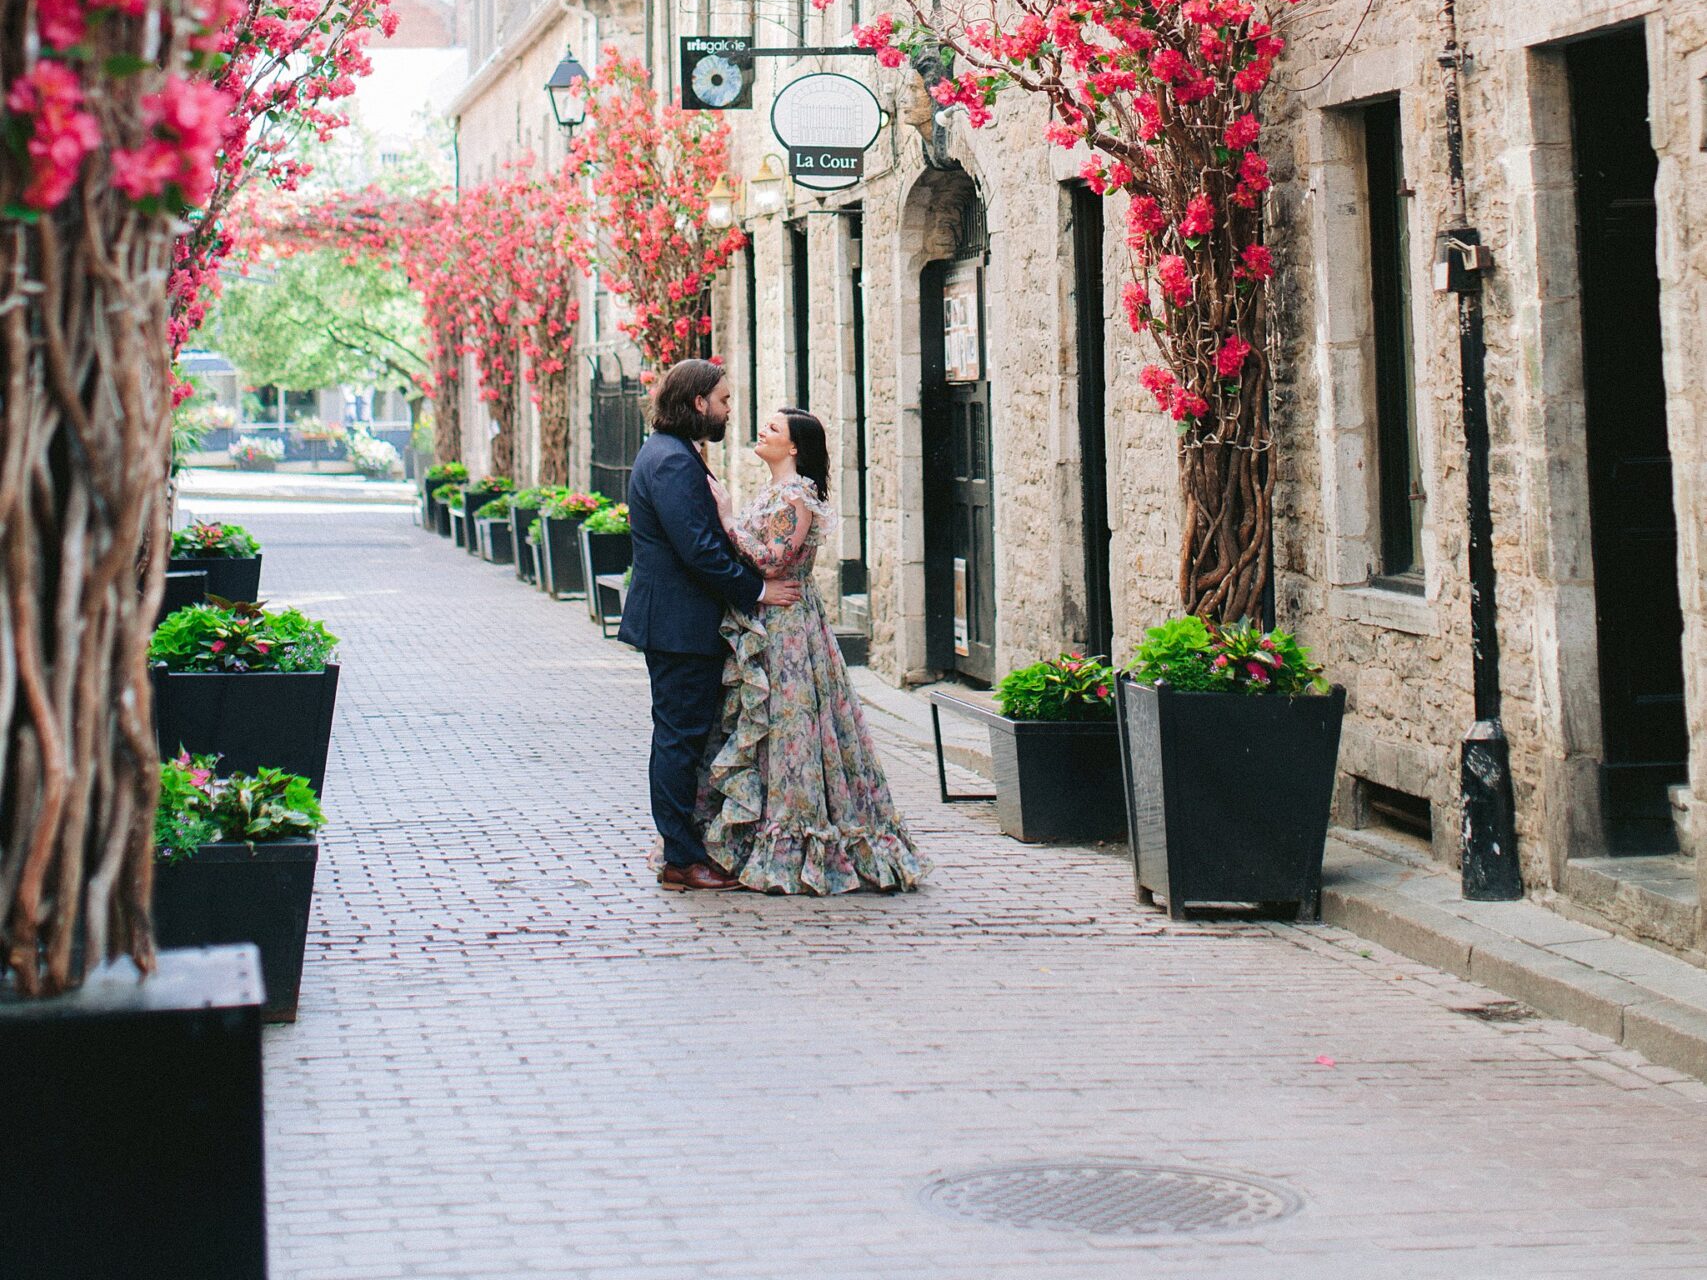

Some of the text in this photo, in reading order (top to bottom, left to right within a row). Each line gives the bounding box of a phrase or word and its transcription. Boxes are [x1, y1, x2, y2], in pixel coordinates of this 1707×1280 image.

[686, 38, 746, 54] irisgalie
[796, 153, 858, 169] La Cour
